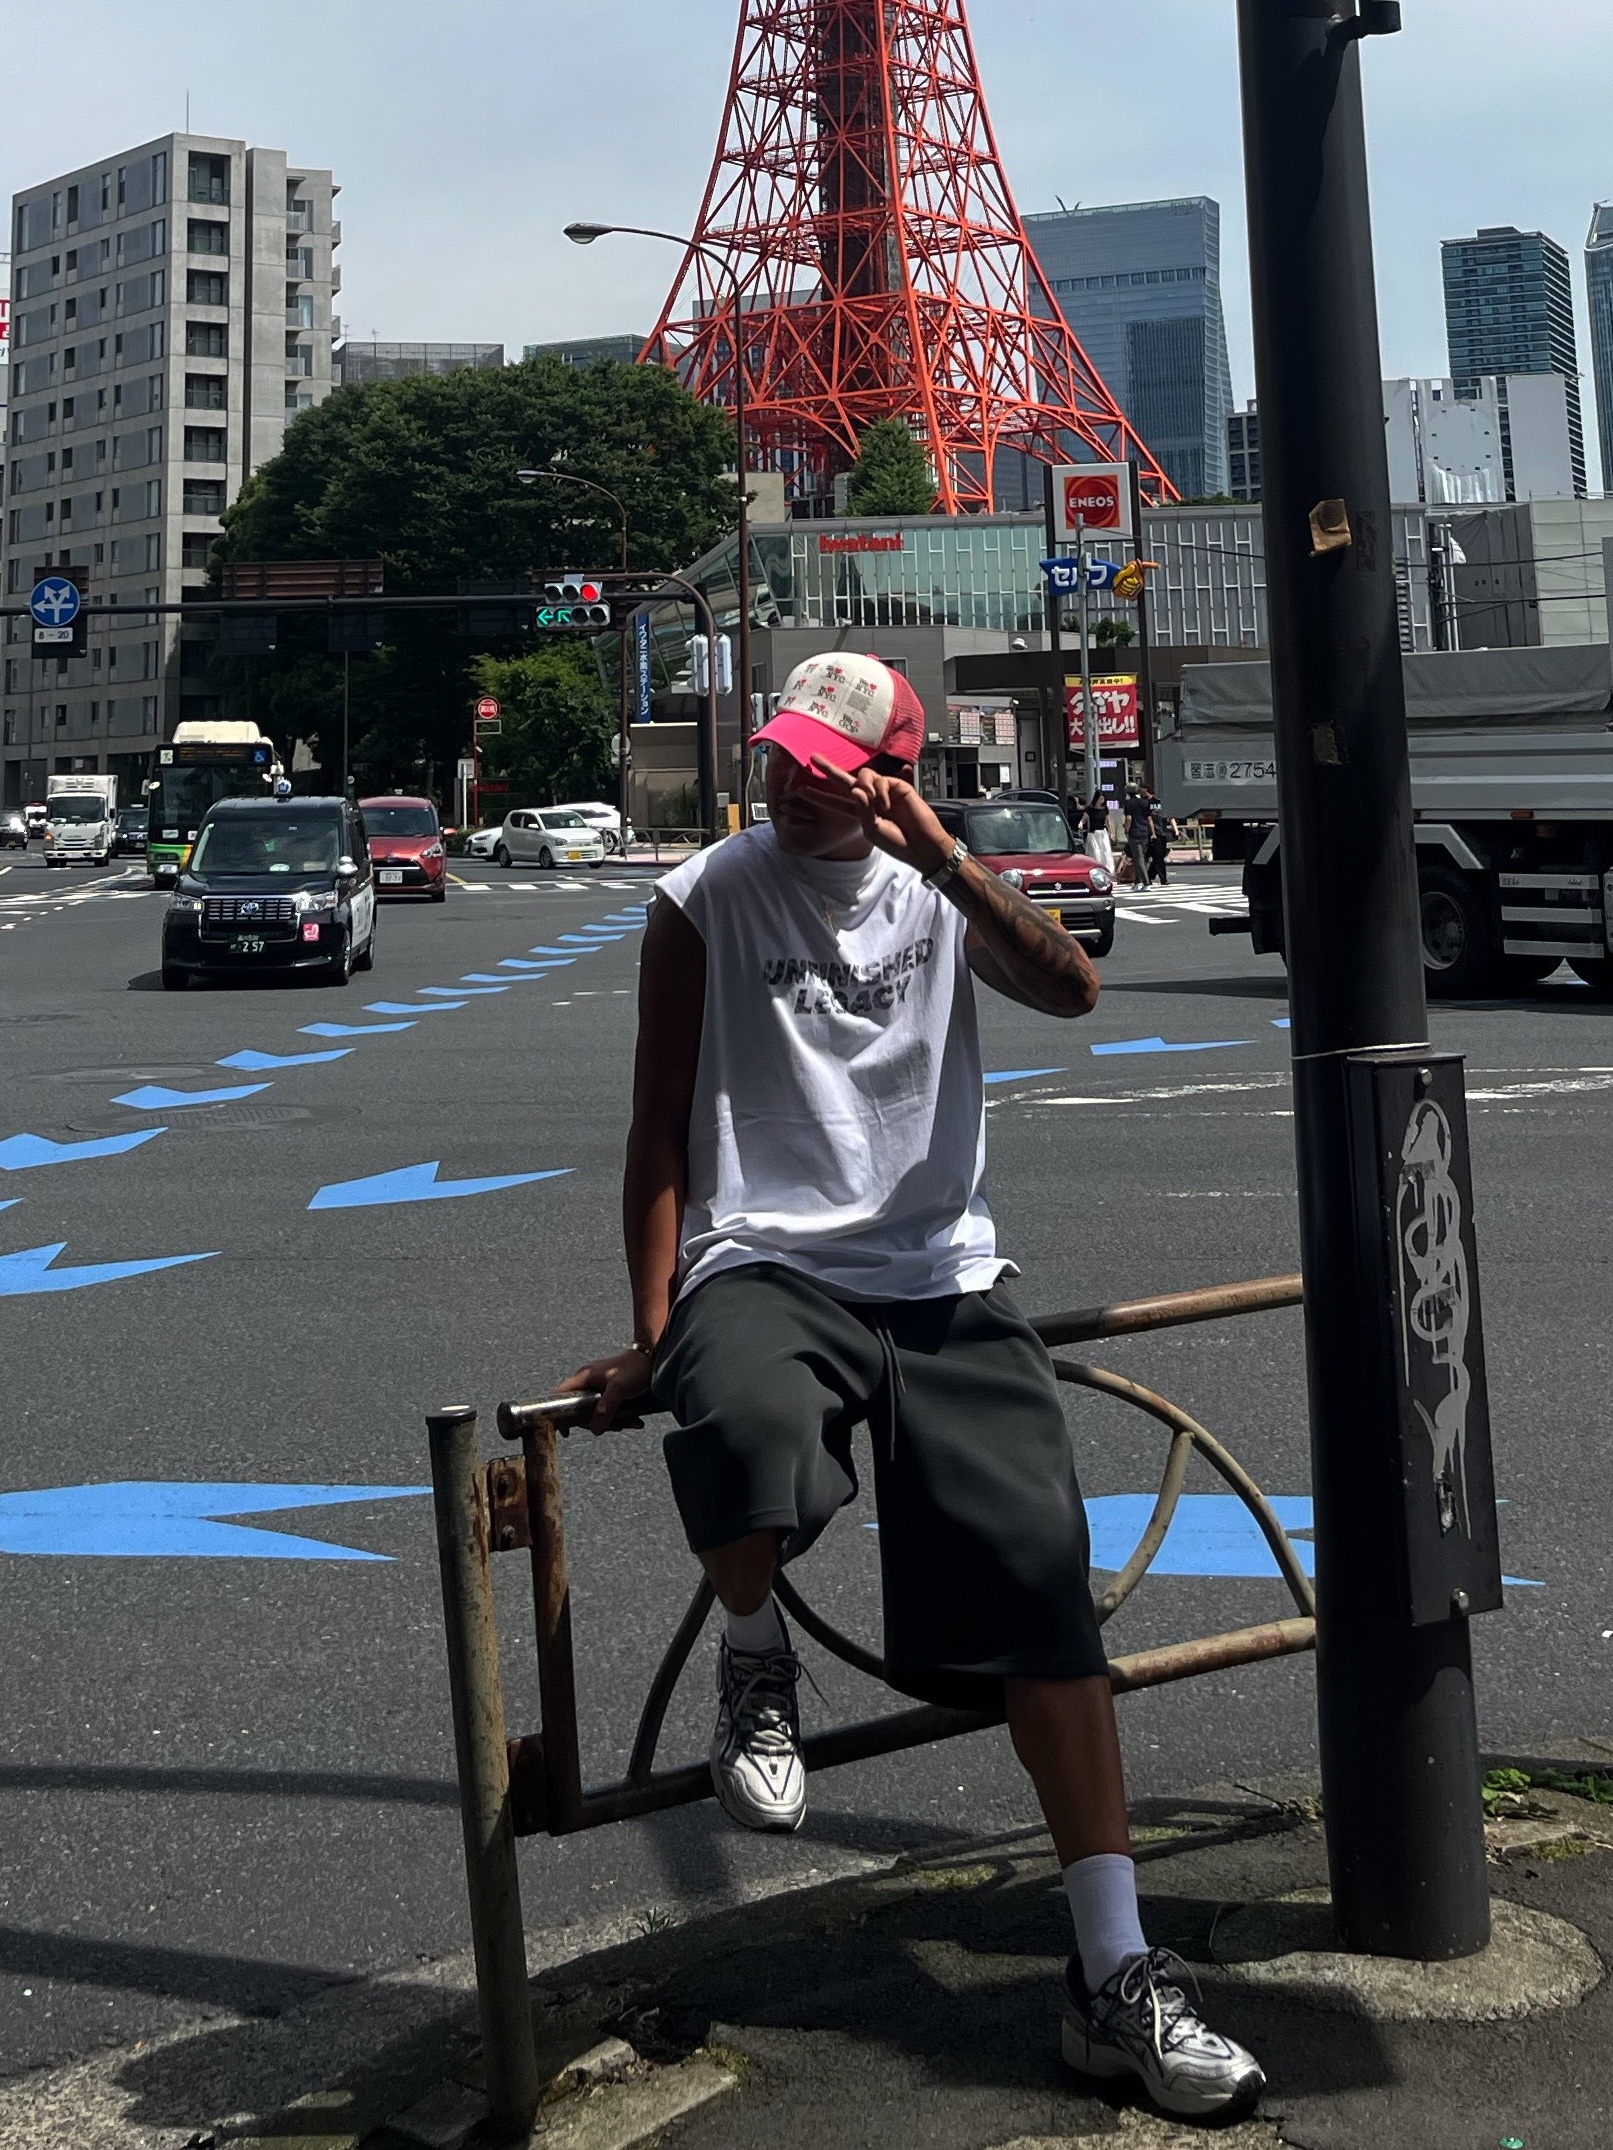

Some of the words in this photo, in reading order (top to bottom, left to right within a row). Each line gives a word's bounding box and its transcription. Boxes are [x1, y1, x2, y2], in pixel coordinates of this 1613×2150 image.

[1069, 495, 1114, 508] ENEOS
[819, 532, 904, 553] Iwatani
[1069, 715, 1136, 736] 大出し!!
